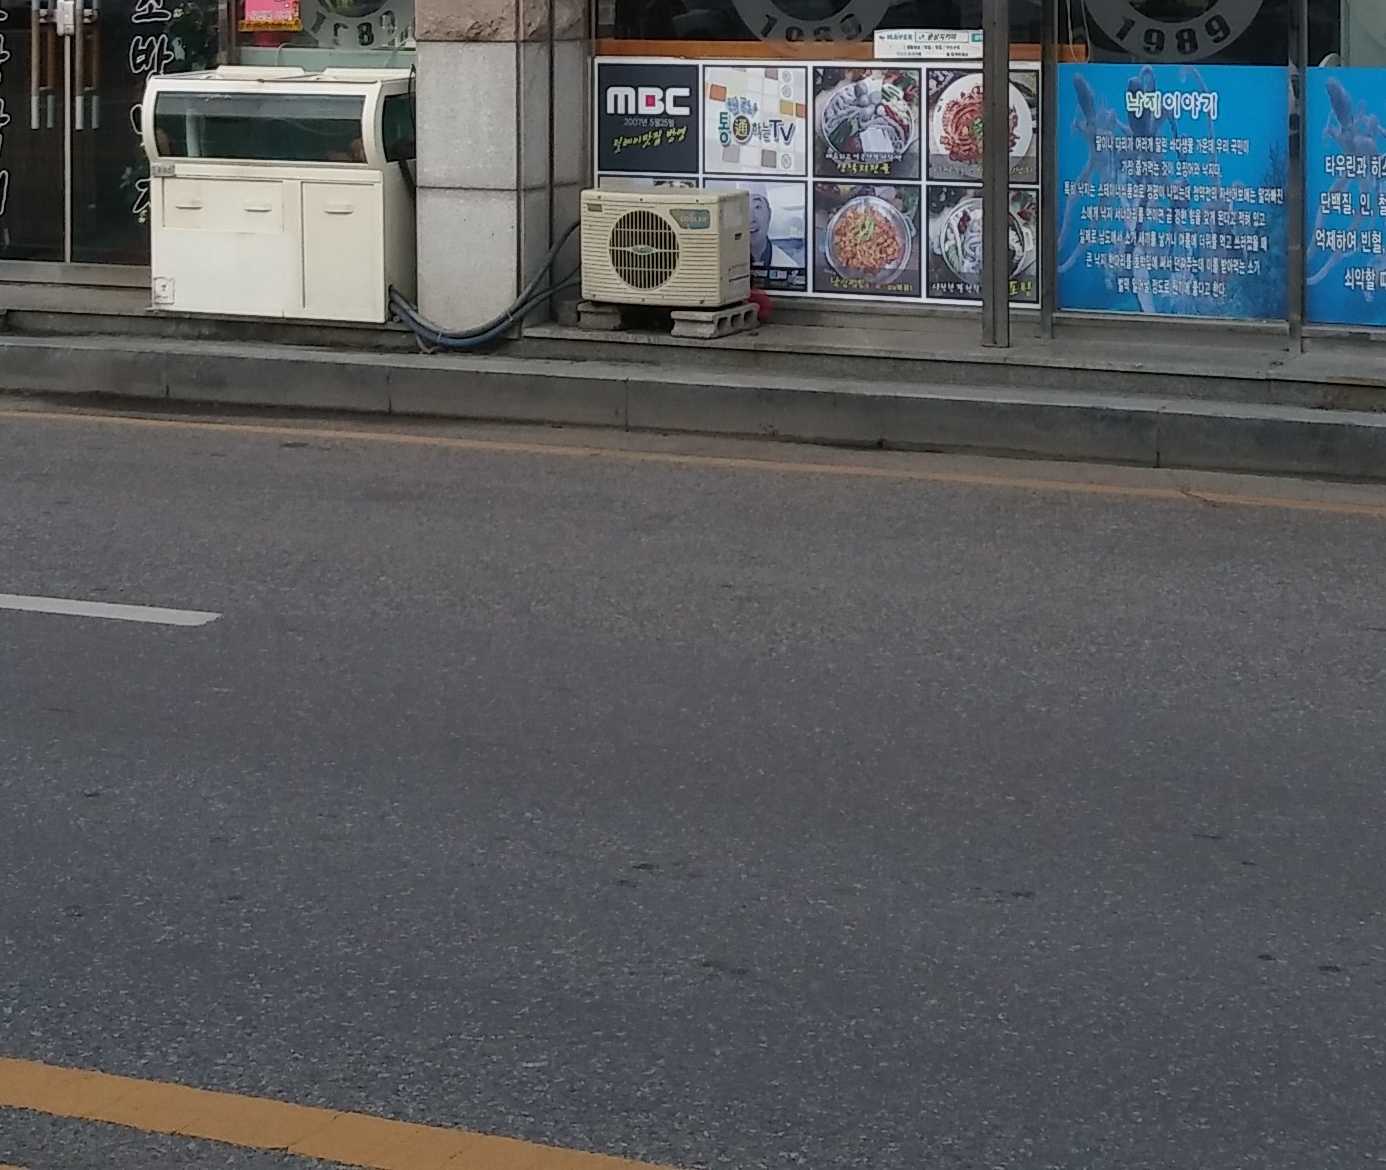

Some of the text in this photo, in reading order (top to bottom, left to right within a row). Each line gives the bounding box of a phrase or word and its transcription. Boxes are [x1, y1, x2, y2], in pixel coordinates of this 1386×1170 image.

[606, 86, 691, 116] MBC
[1325, 155, 1367, 178] 타우린과
[1316, 229, 1357, 252] 억제하여
[1345, 268, 1376, 292] 쇠약할
